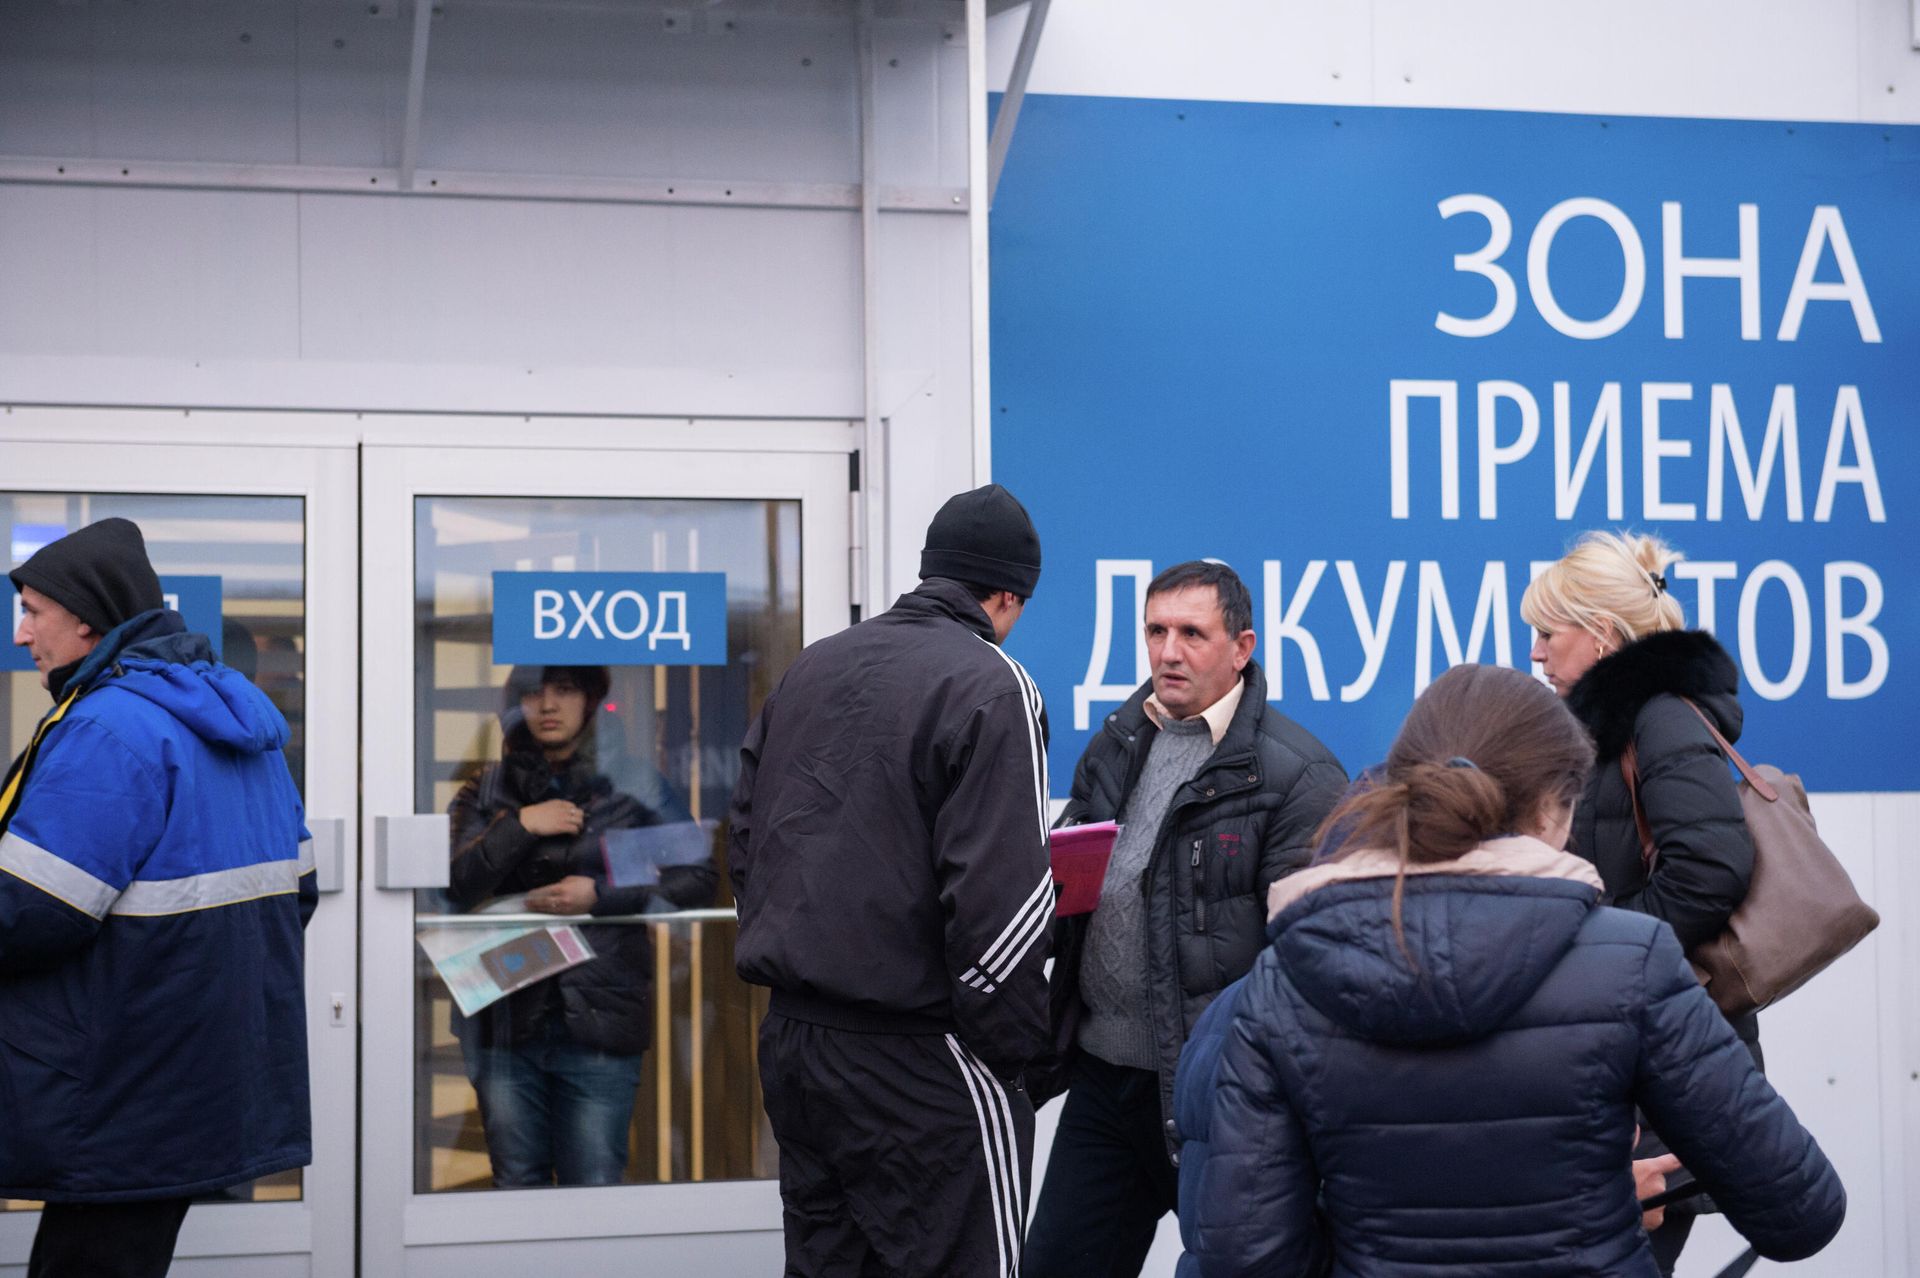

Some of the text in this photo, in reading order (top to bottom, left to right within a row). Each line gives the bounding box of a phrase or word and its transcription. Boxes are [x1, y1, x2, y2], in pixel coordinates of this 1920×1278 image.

[1435, 194, 1882, 343] ЗОНА
[1389, 379, 1887, 522] ПРИЕМА
[534, 589, 690, 651] ВХОД
[1073, 558, 1889, 731] ДКУМТОВ
